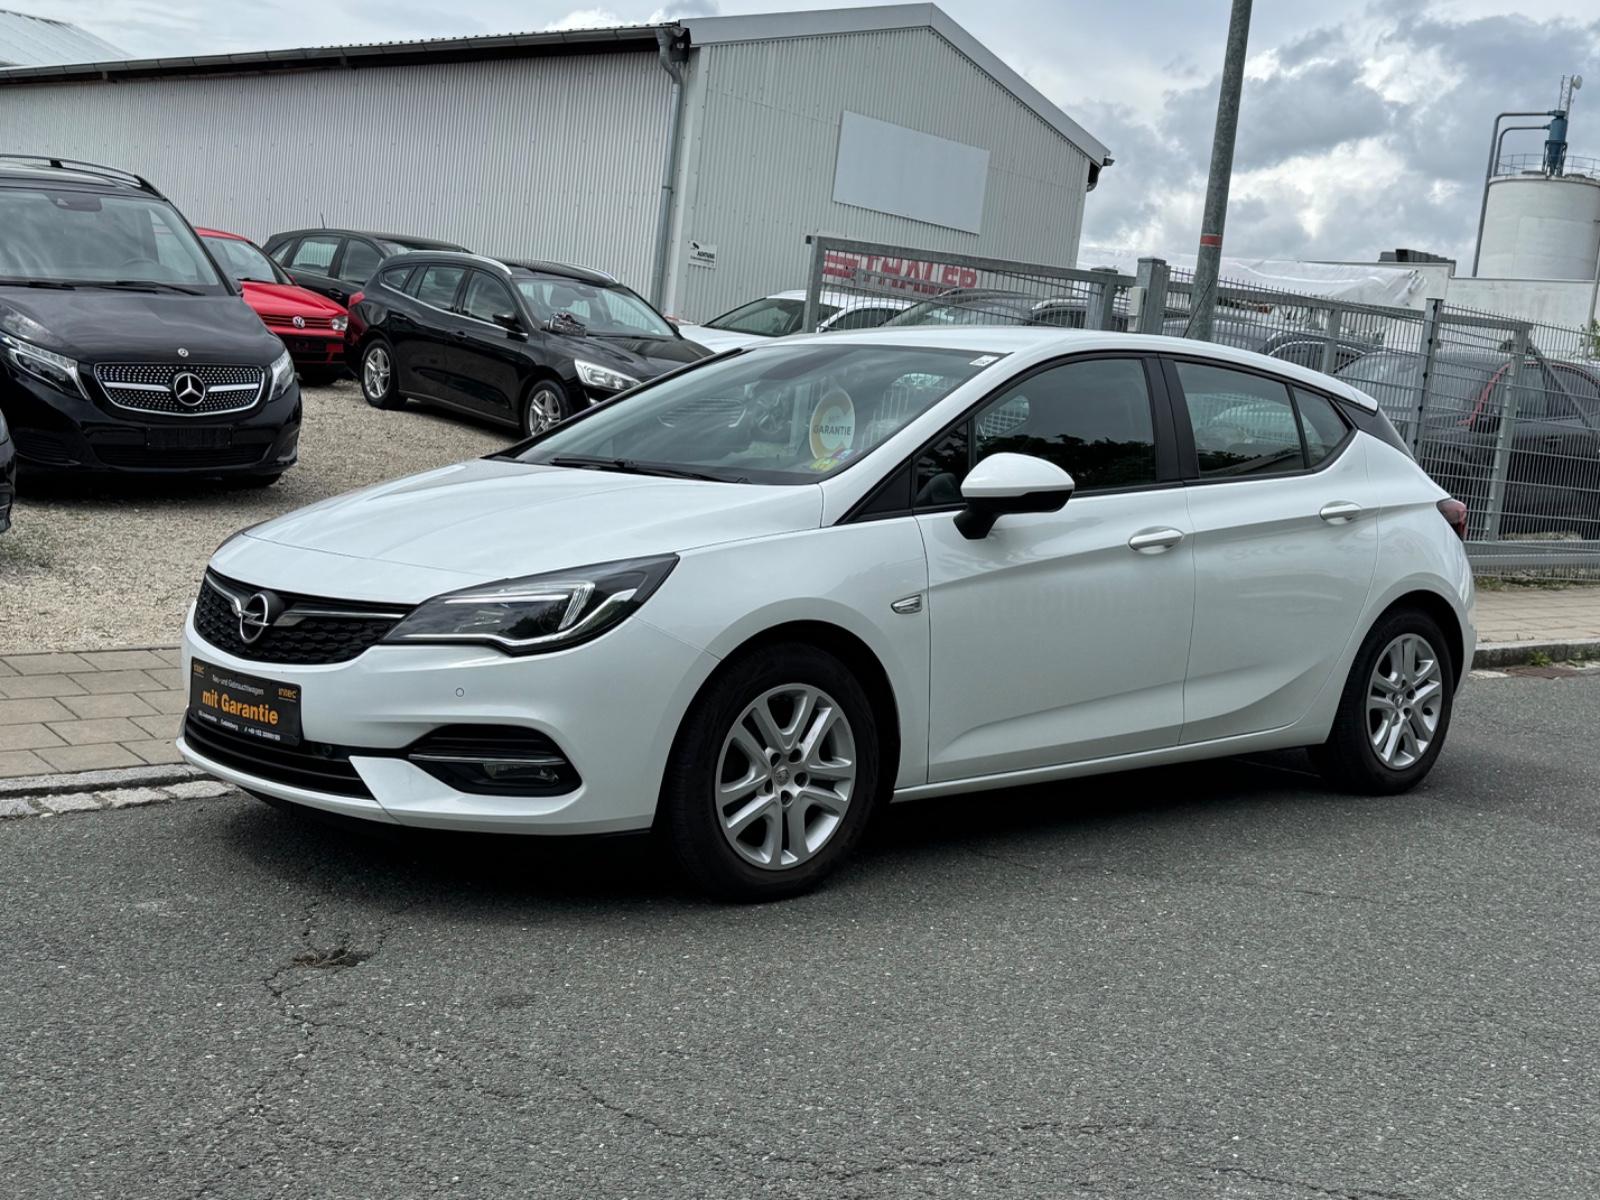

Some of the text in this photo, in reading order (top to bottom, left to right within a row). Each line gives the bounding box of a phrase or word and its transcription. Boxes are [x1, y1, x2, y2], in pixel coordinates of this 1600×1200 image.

[813, 424, 852, 436] GARANTIE
[202, 689, 218, 708] mit
[221, 693, 279, 725] Garantie
